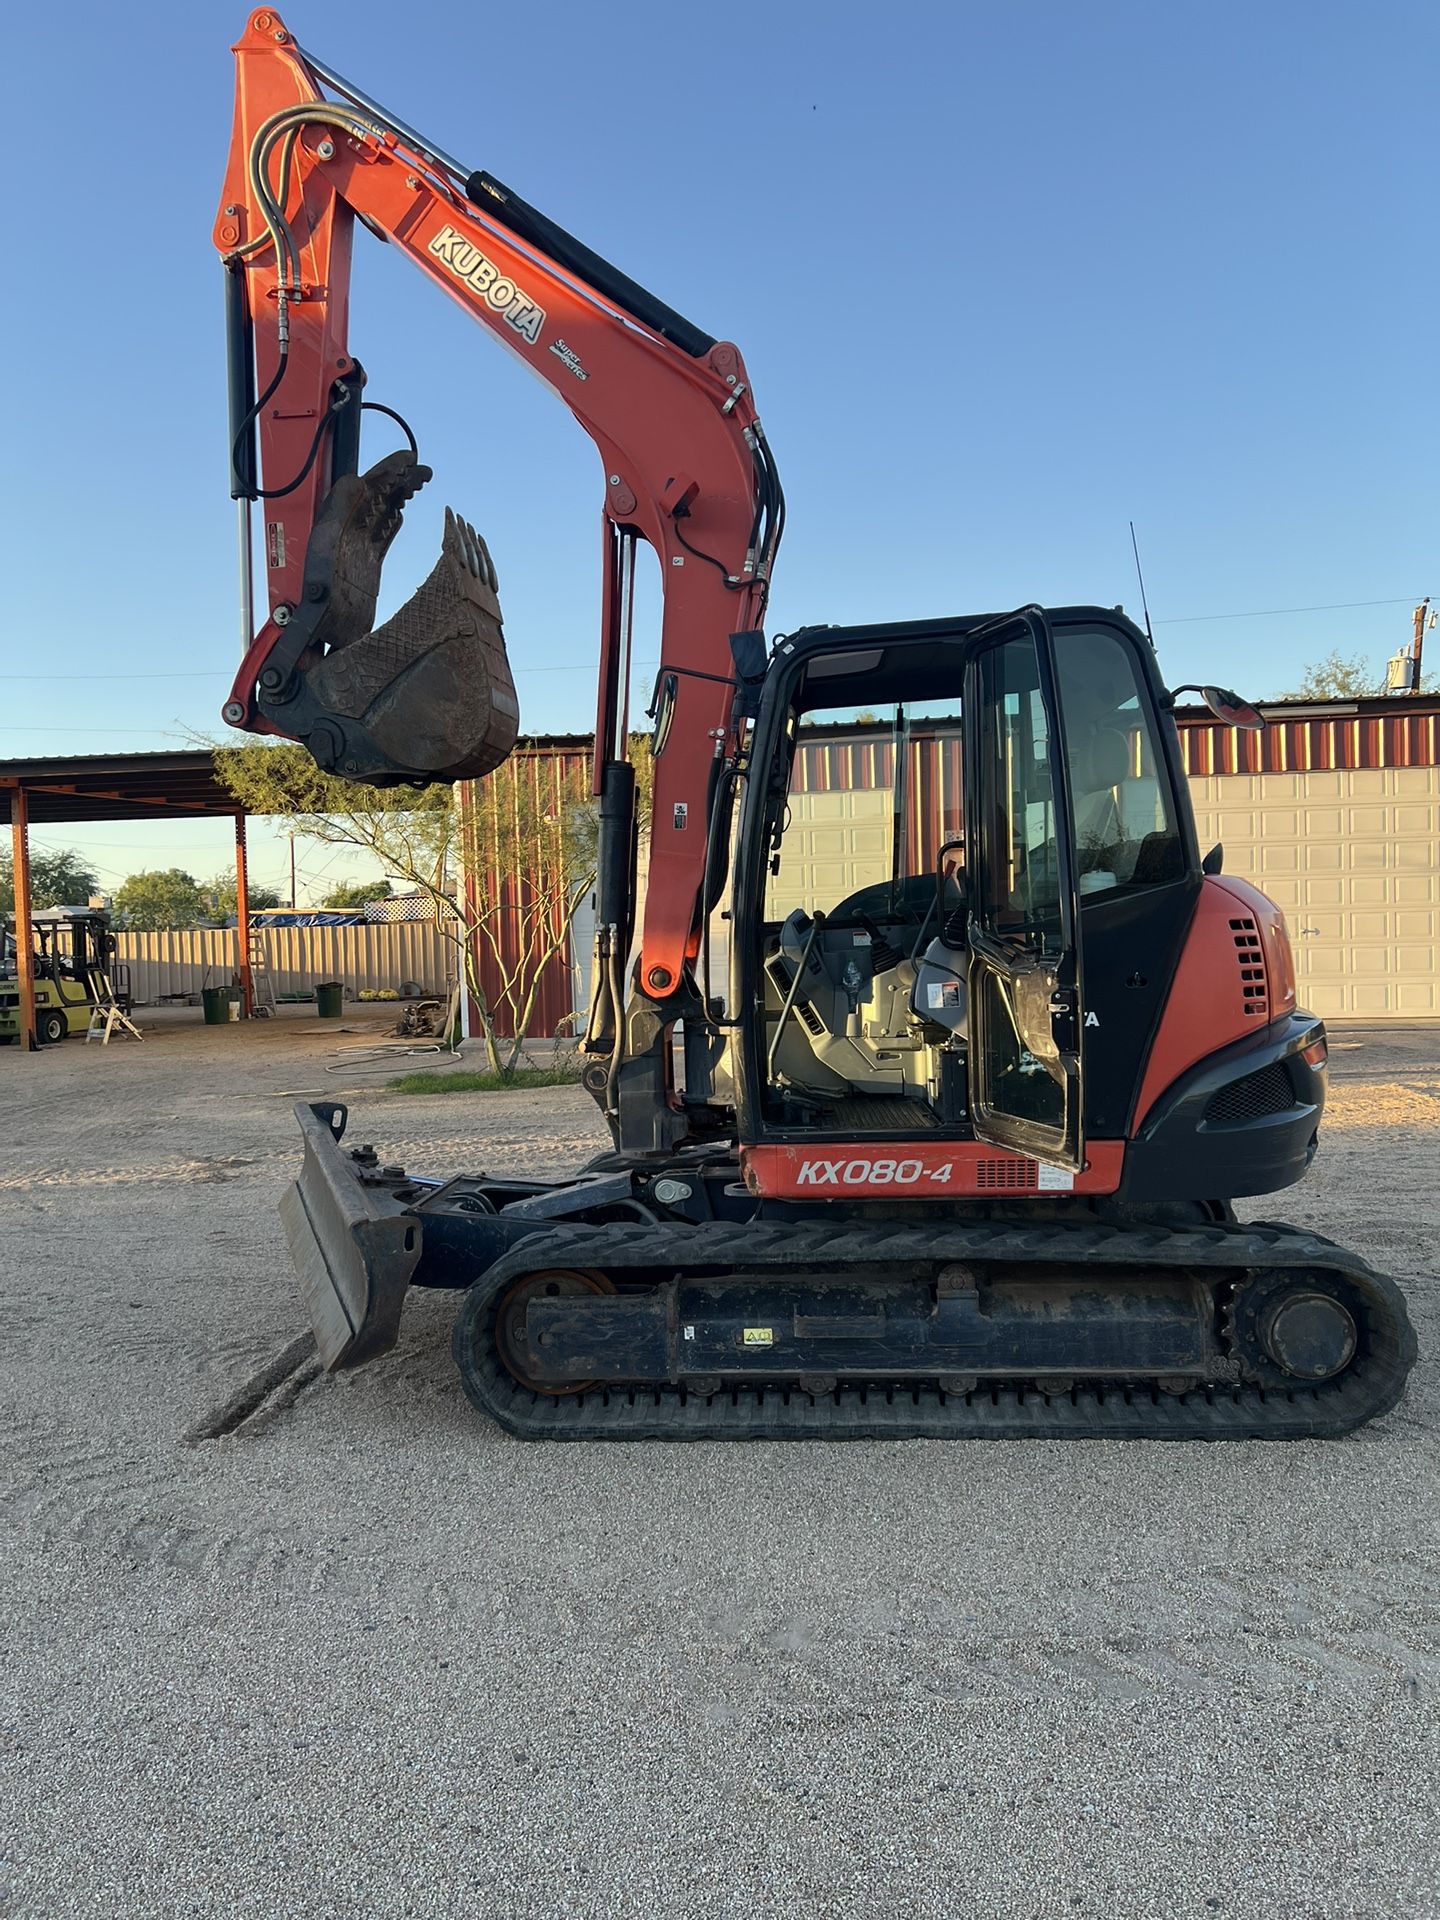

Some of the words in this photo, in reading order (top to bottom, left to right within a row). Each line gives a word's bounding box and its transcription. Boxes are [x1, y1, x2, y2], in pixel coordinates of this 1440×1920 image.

[429, 225, 545, 343] KUBOTA
[555, 339, 581, 364] Super
[797, 1160, 952, 1184] KX080-4
